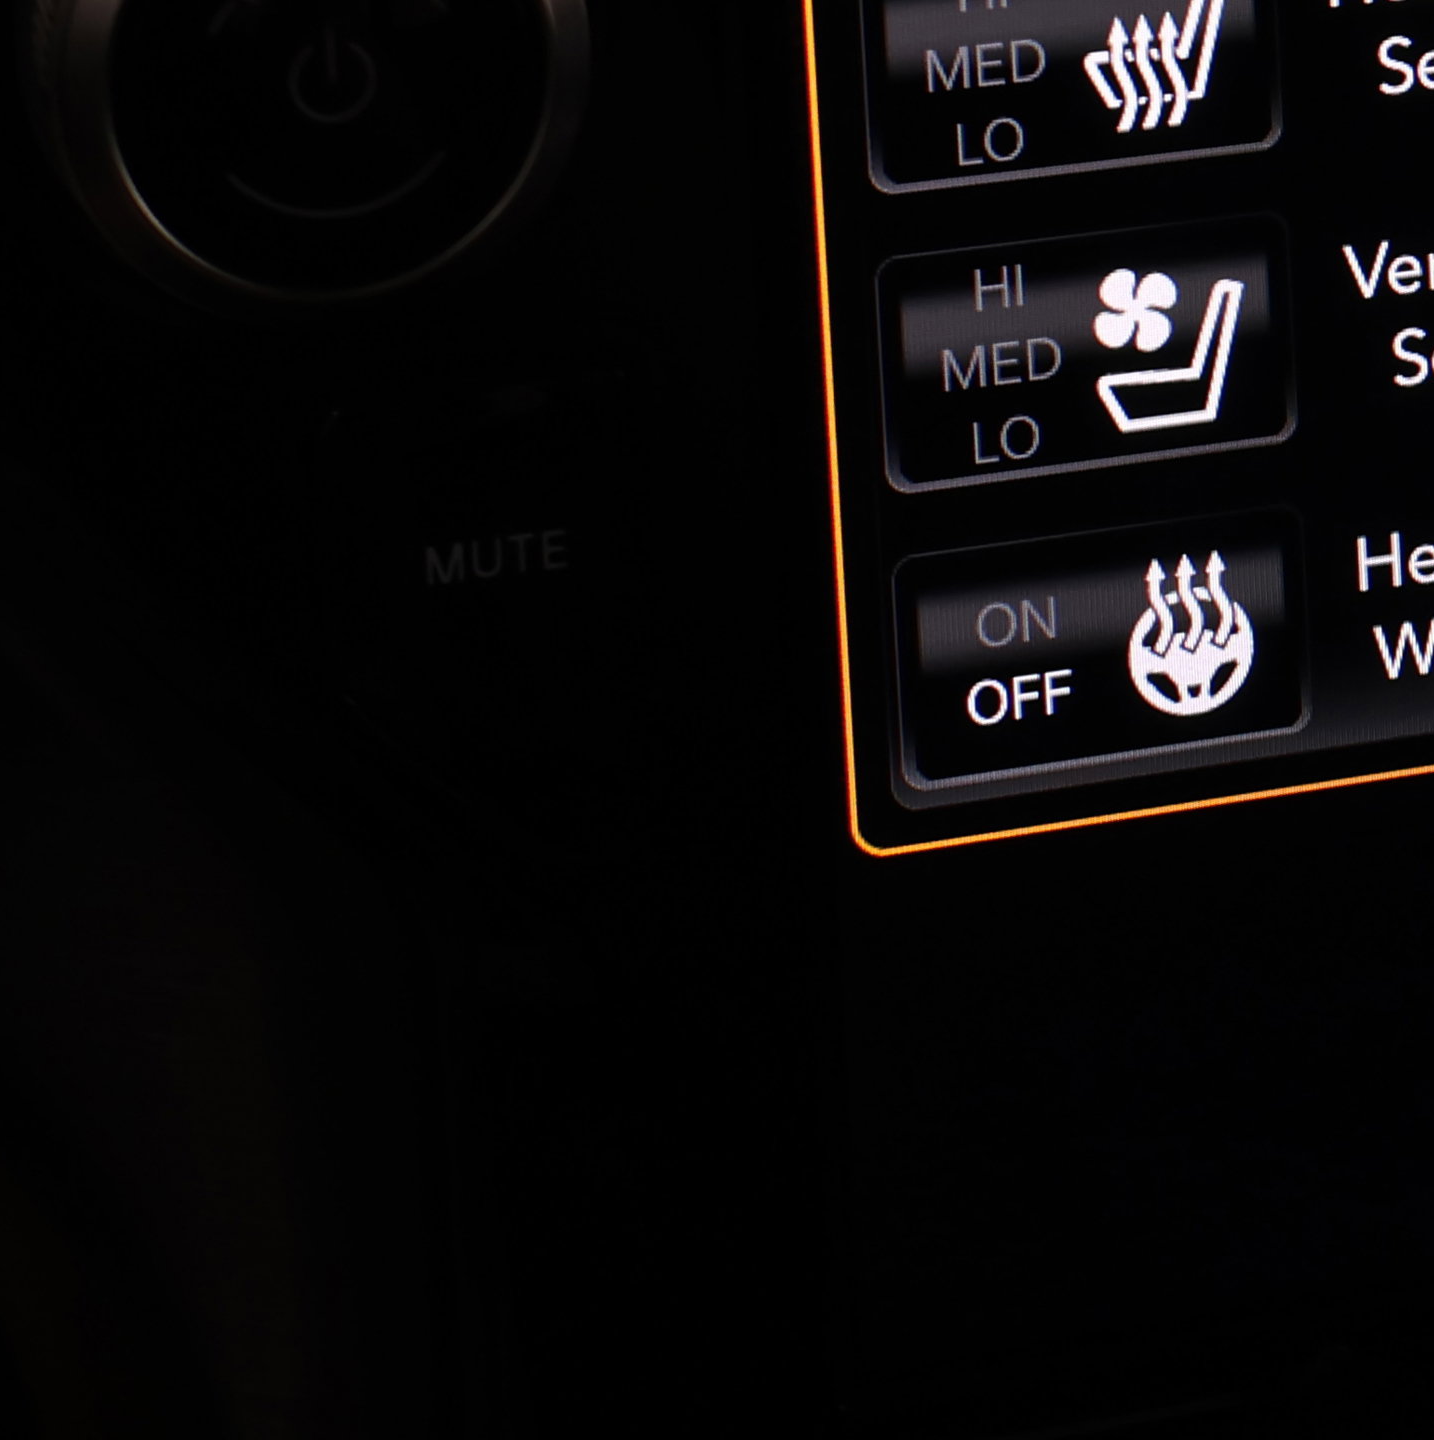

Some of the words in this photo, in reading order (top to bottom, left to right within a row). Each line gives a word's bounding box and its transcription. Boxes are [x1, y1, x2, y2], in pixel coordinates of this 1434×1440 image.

[924, 40, 1048, 95] MED
[954, 117, 1026, 167] LO
[972, 263, 1026, 310] HI
[941, 336, 1063, 391] MED
[970, 414, 1042, 466] LO
[424, 527, 570, 588] MUTE
[975, 595, 1059, 649] ON
[965, 668, 1073, 728] OFF
